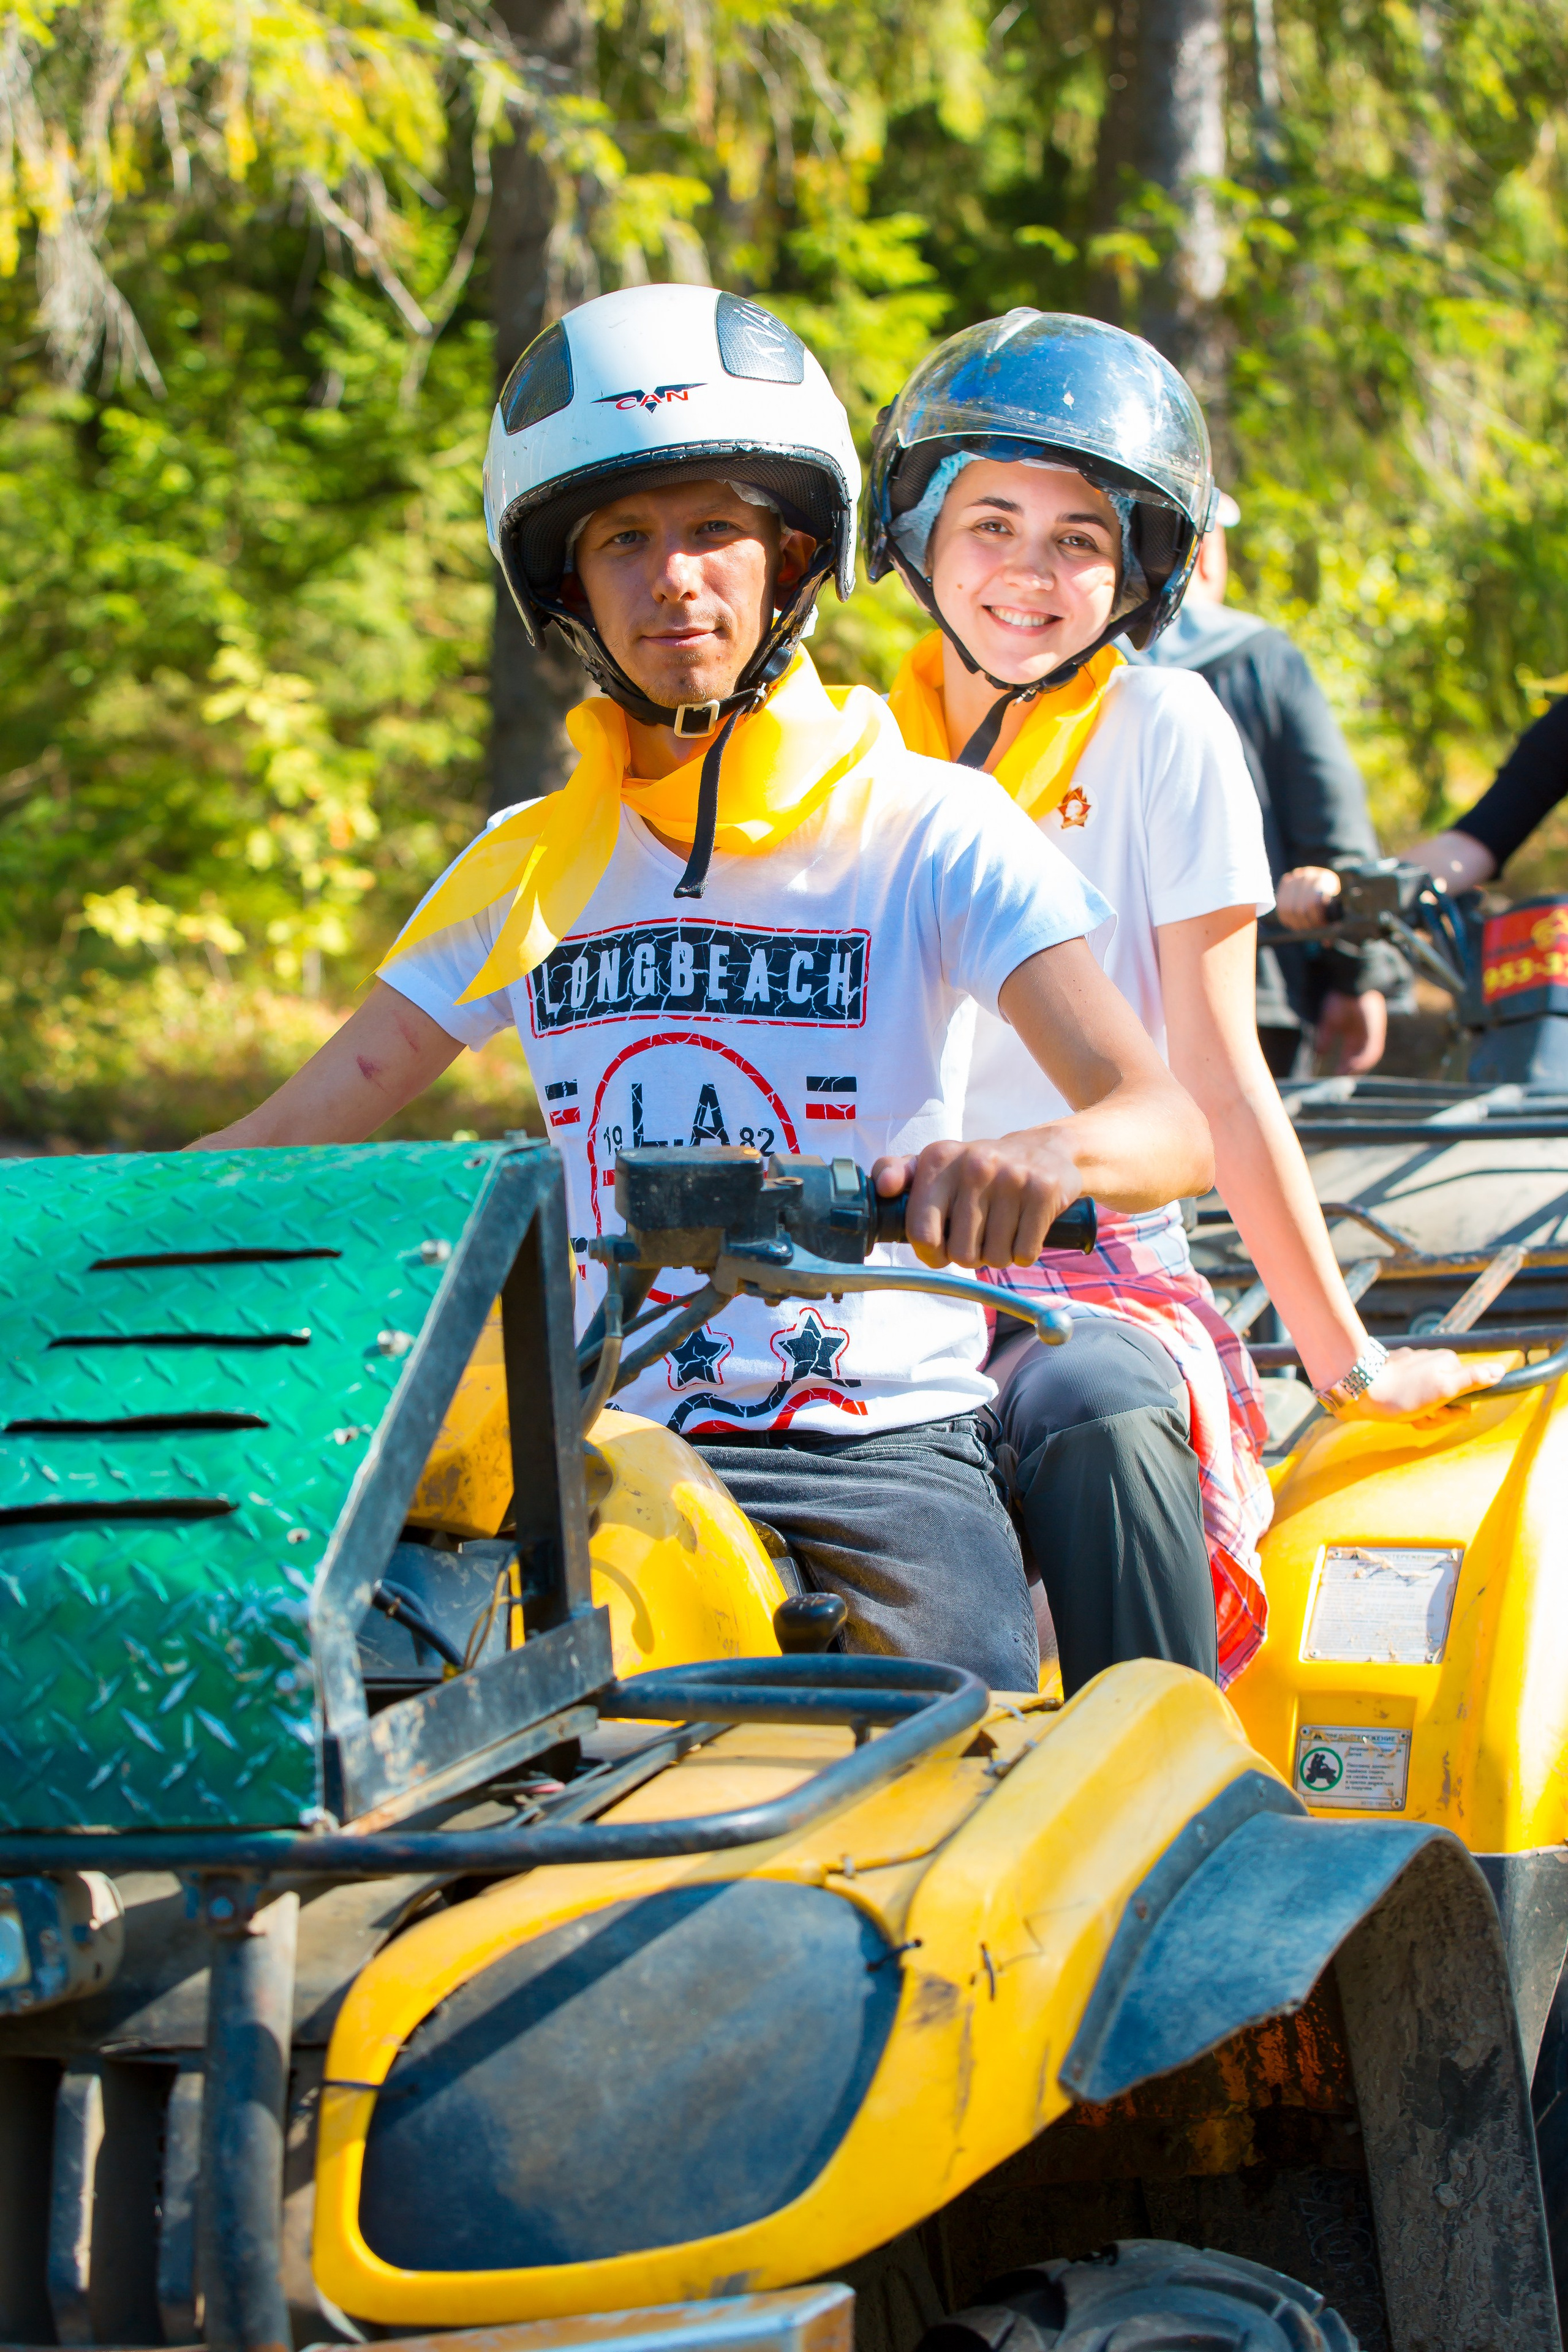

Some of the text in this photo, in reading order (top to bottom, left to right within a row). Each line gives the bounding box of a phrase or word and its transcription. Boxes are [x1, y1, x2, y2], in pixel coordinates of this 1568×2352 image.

[615, 390, 688, 410] CAN
[542, 941, 852, 1016] LONGBEACH
[603, 1125, 775, 1157] 19 82
